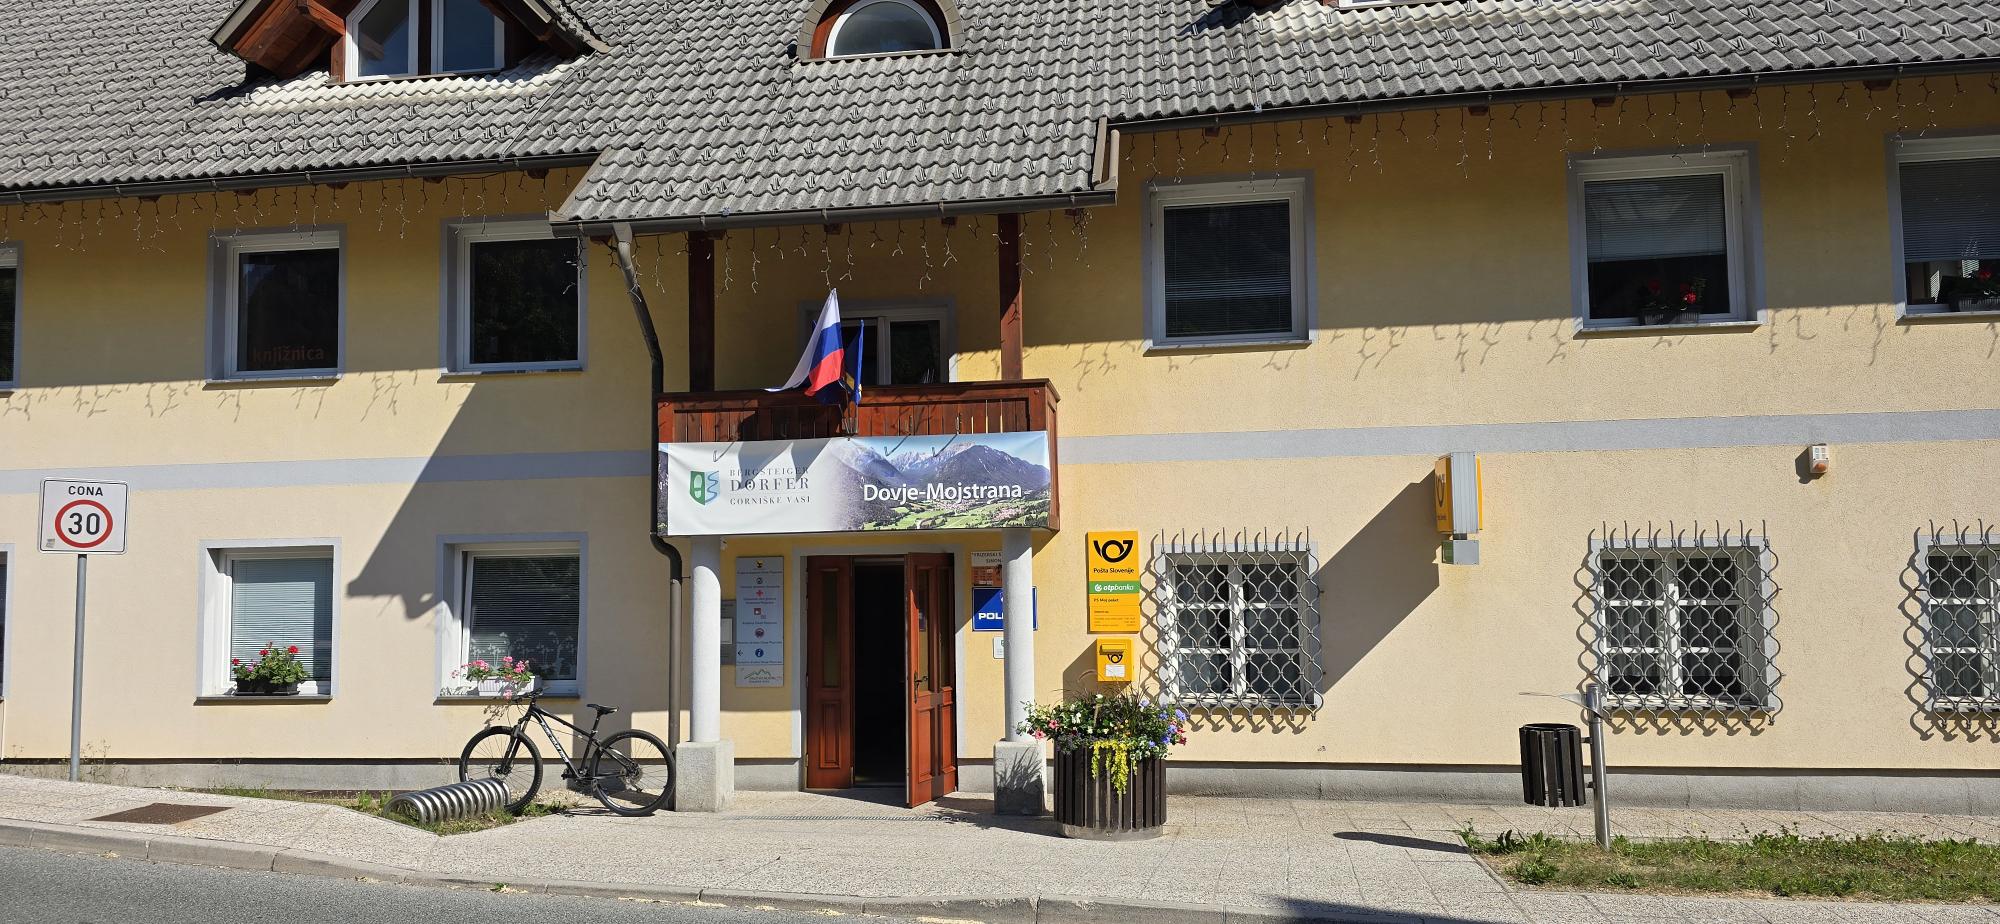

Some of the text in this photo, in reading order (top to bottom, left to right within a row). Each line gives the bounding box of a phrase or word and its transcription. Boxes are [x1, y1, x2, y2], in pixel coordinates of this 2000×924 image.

[730, 467, 809, 477] BERGSTEIGER
[68, 486, 103, 496] CONA
[863, 482, 1022, 504] Dovje-Mojstrana
[68, 512, 100, 535] 30
